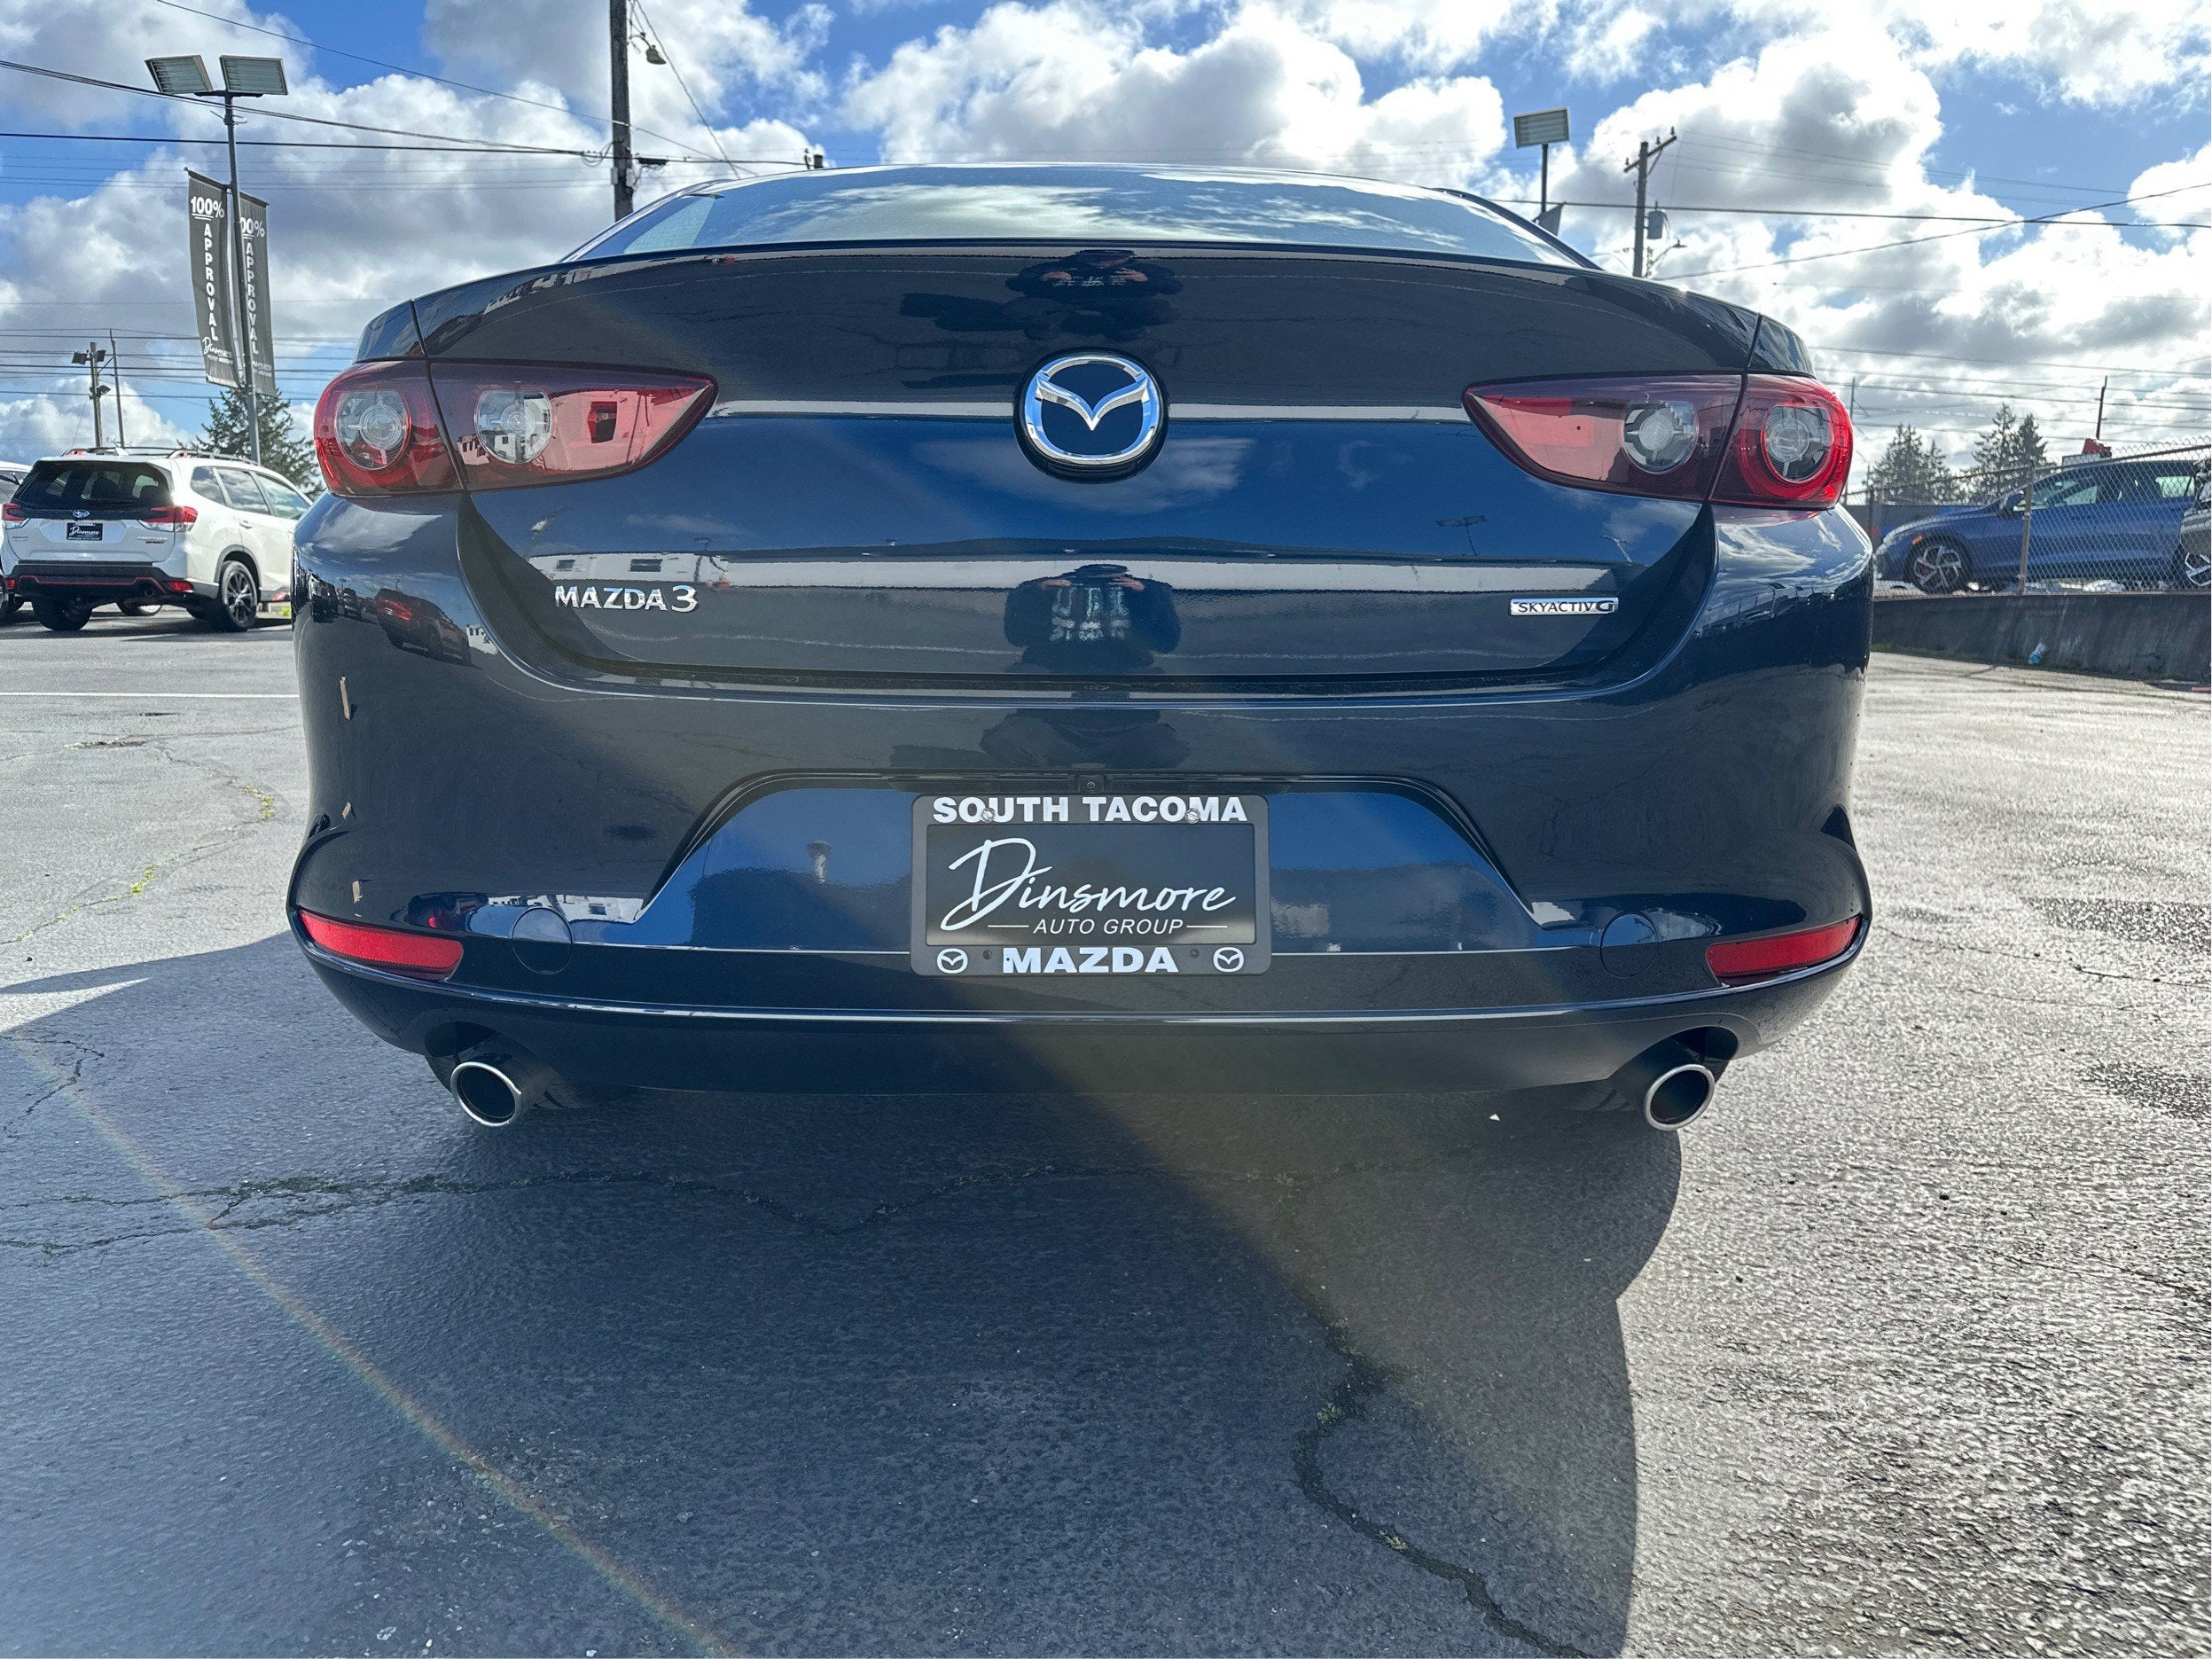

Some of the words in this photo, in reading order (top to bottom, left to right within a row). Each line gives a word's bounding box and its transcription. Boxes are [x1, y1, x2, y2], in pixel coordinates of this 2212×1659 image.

[190, 196, 225, 219] 100%
[239, 216, 265, 238] 00%
[204, 223, 219, 341] APPROVAL
[246, 242, 259, 355] APPROVAL
[933, 796, 1070, 824] SOUTH
[1083, 796, 1247, 823] TACOMA
[940, 837, 1237, 932] Dinsmore
[1033, 919, 1096, 935] AUTO
[1104, 919, 1184, 935] GROUP
[1003, 947, 1179, 974] MAZDA
